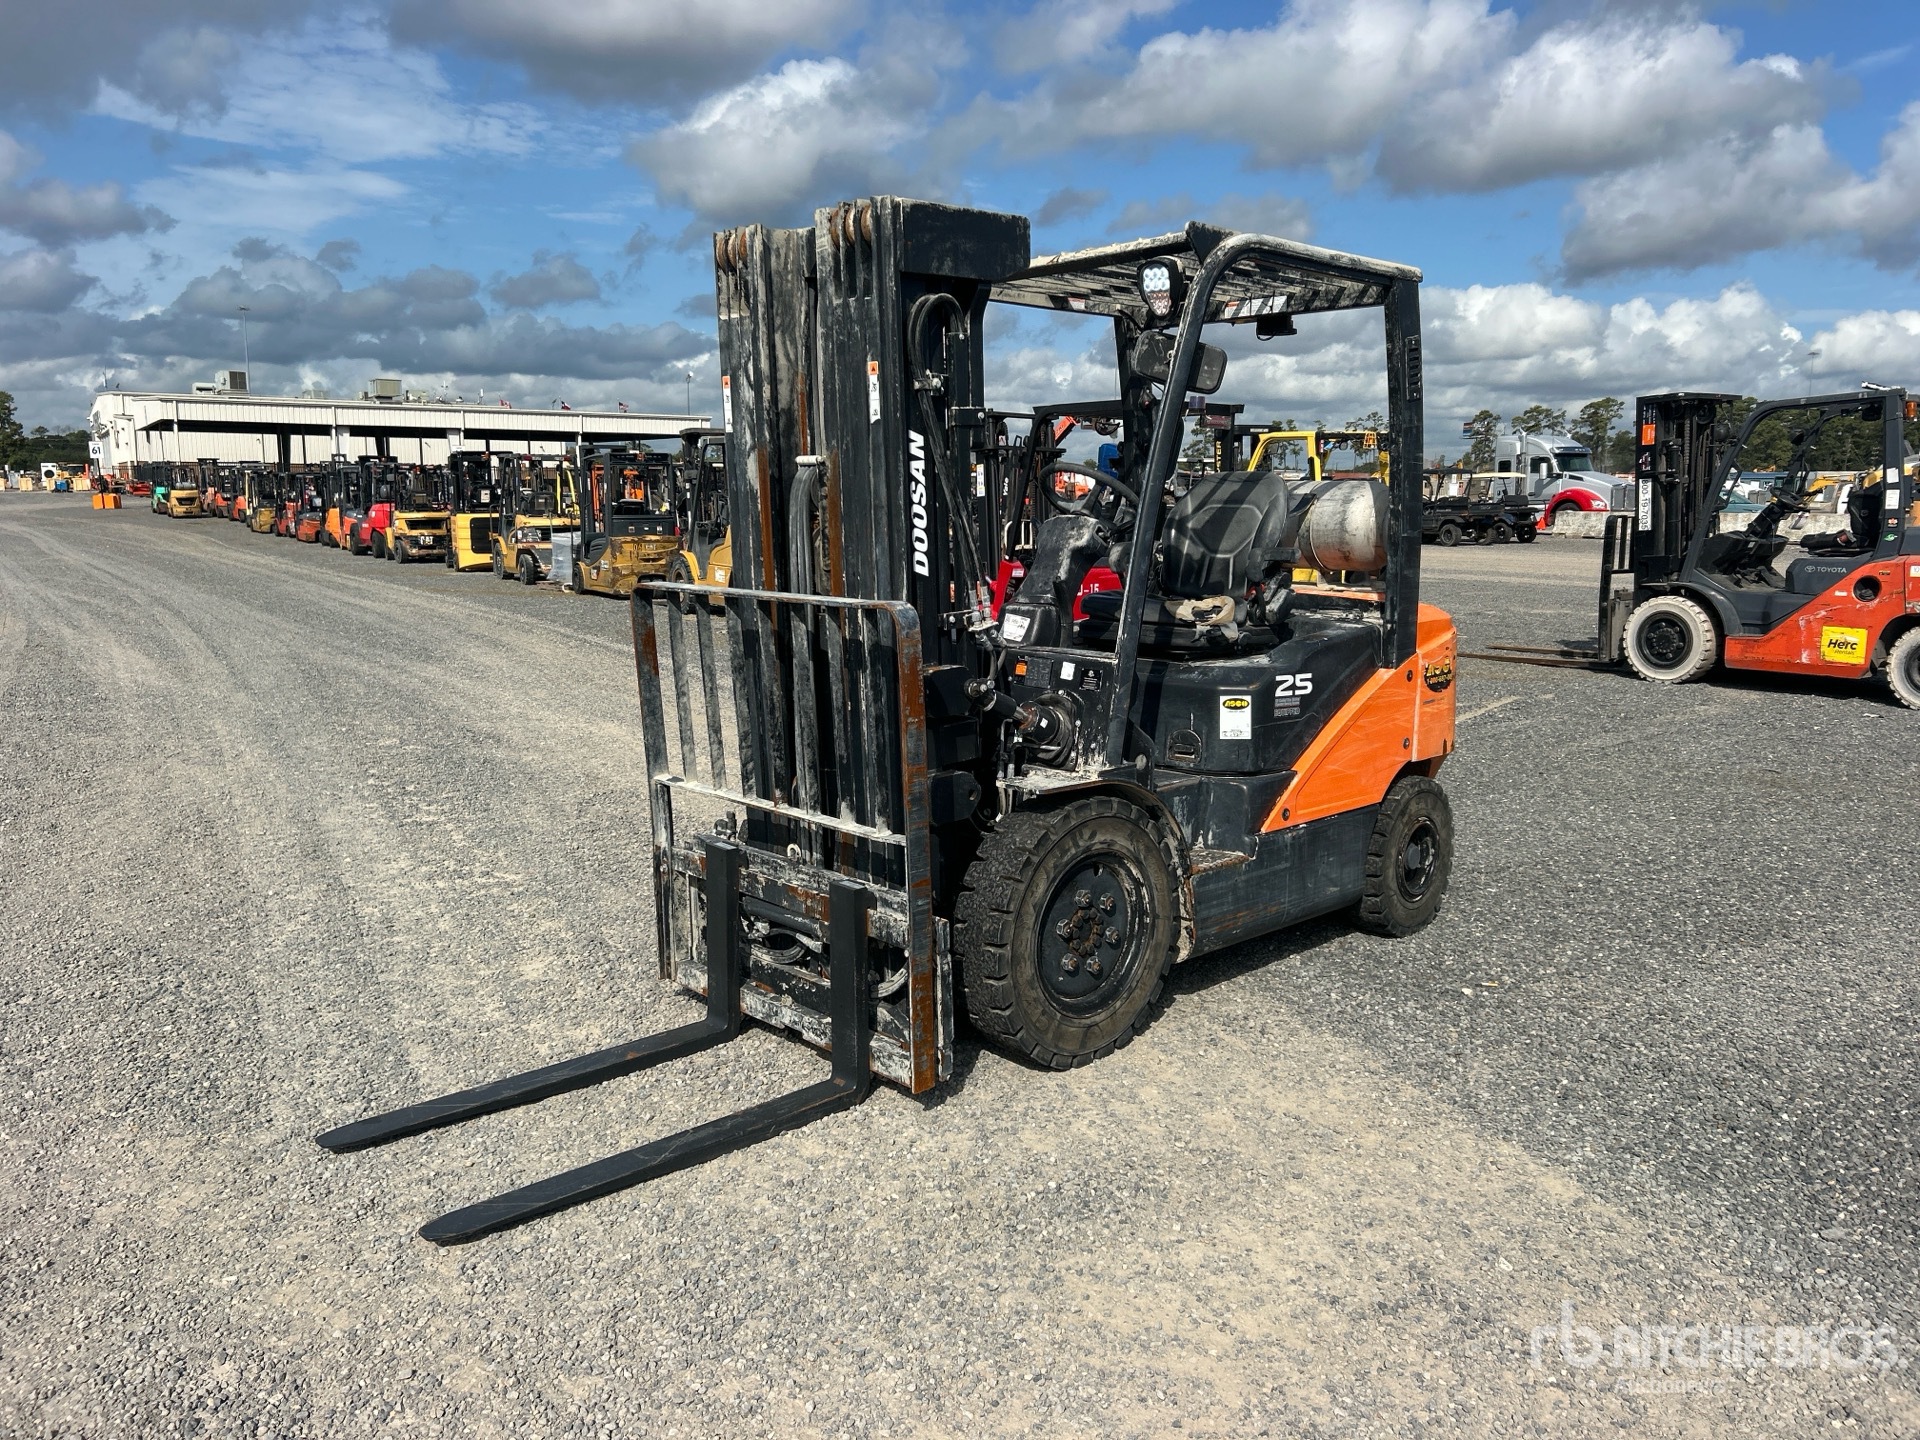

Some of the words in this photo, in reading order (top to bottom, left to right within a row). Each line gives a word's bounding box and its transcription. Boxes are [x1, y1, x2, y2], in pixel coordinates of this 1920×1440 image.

[91, 446, 101, 455] 61
[908, 429, 930, 578] DOOSAN
[1816, 566, 1847, 574] TOYOTA
[1827, 638, 1858, 651] Herc
[1274, 672, 1313, 698] 25
[1223, 700, 1249, 708] ASCO
